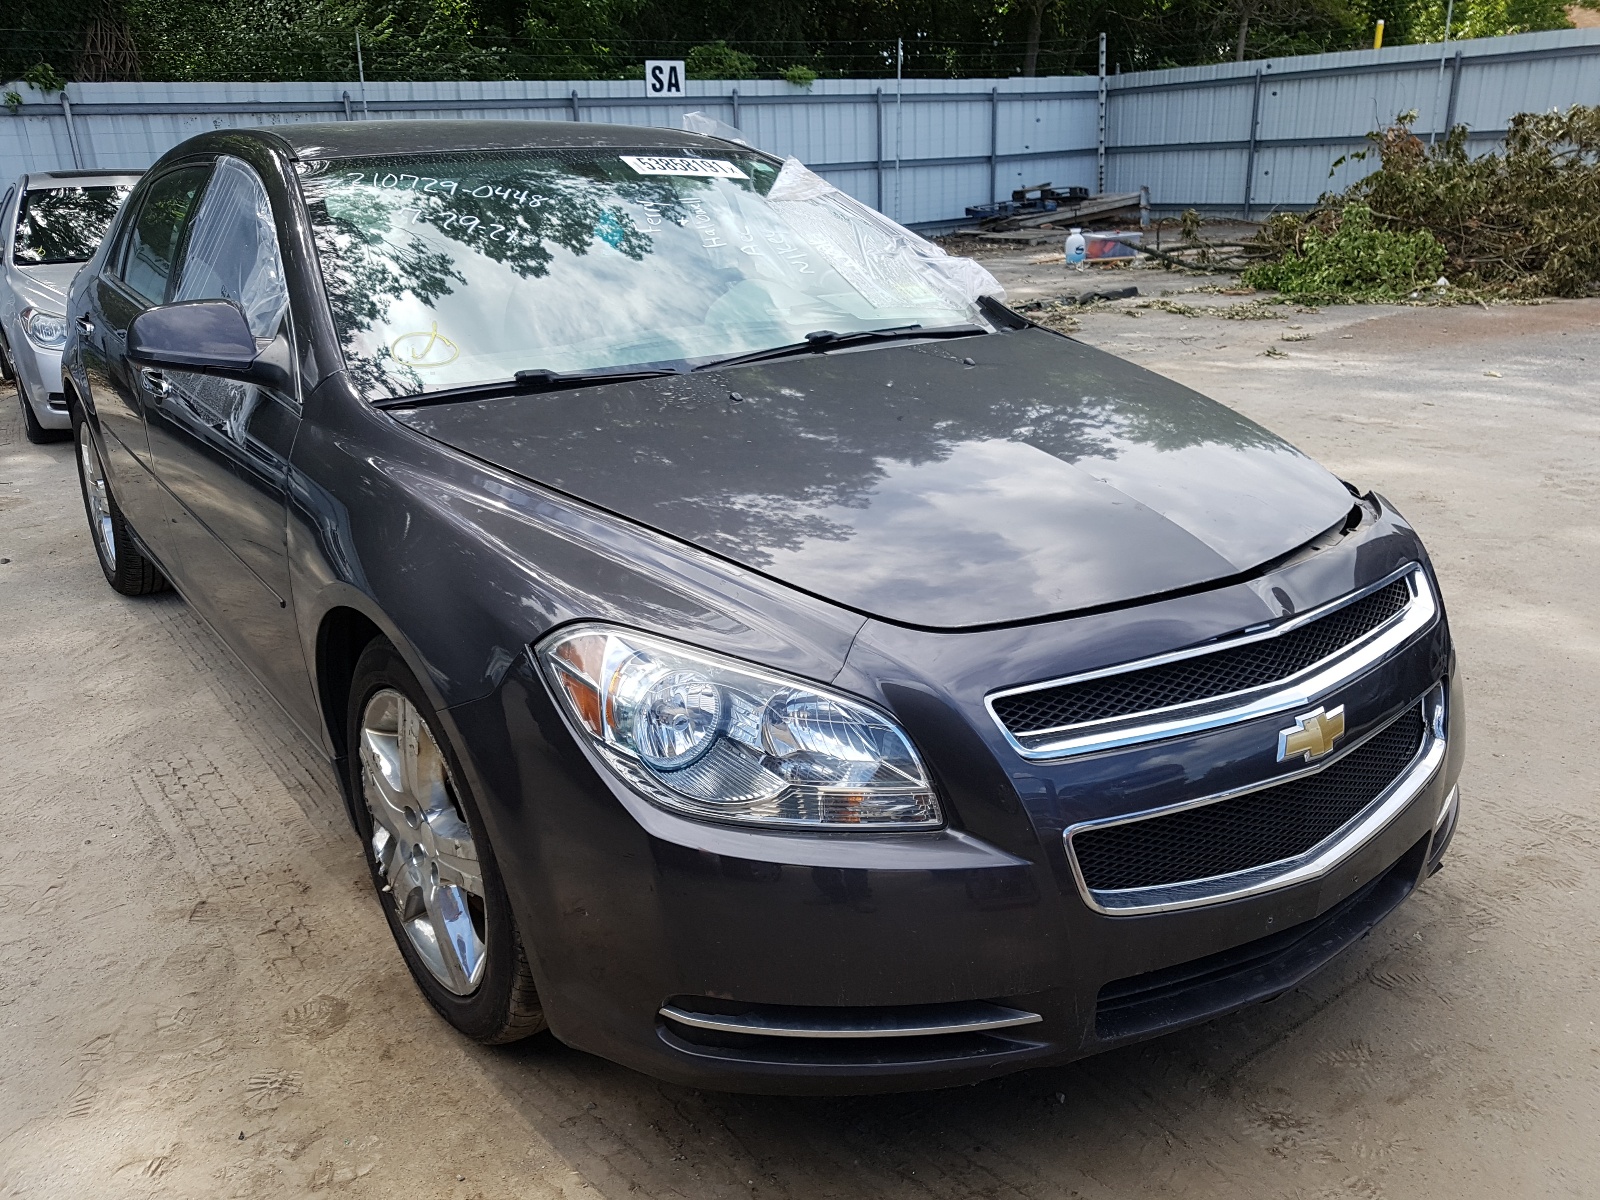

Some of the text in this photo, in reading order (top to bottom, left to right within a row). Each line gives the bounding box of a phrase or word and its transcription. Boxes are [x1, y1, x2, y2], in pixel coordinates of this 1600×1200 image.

[651, 65, 681, 93] SA
[636, 157, 728, 173] 53858191
[347, 172, 550, 207] 210729-0448
[397, 207, 519, 243] 7-29-21
